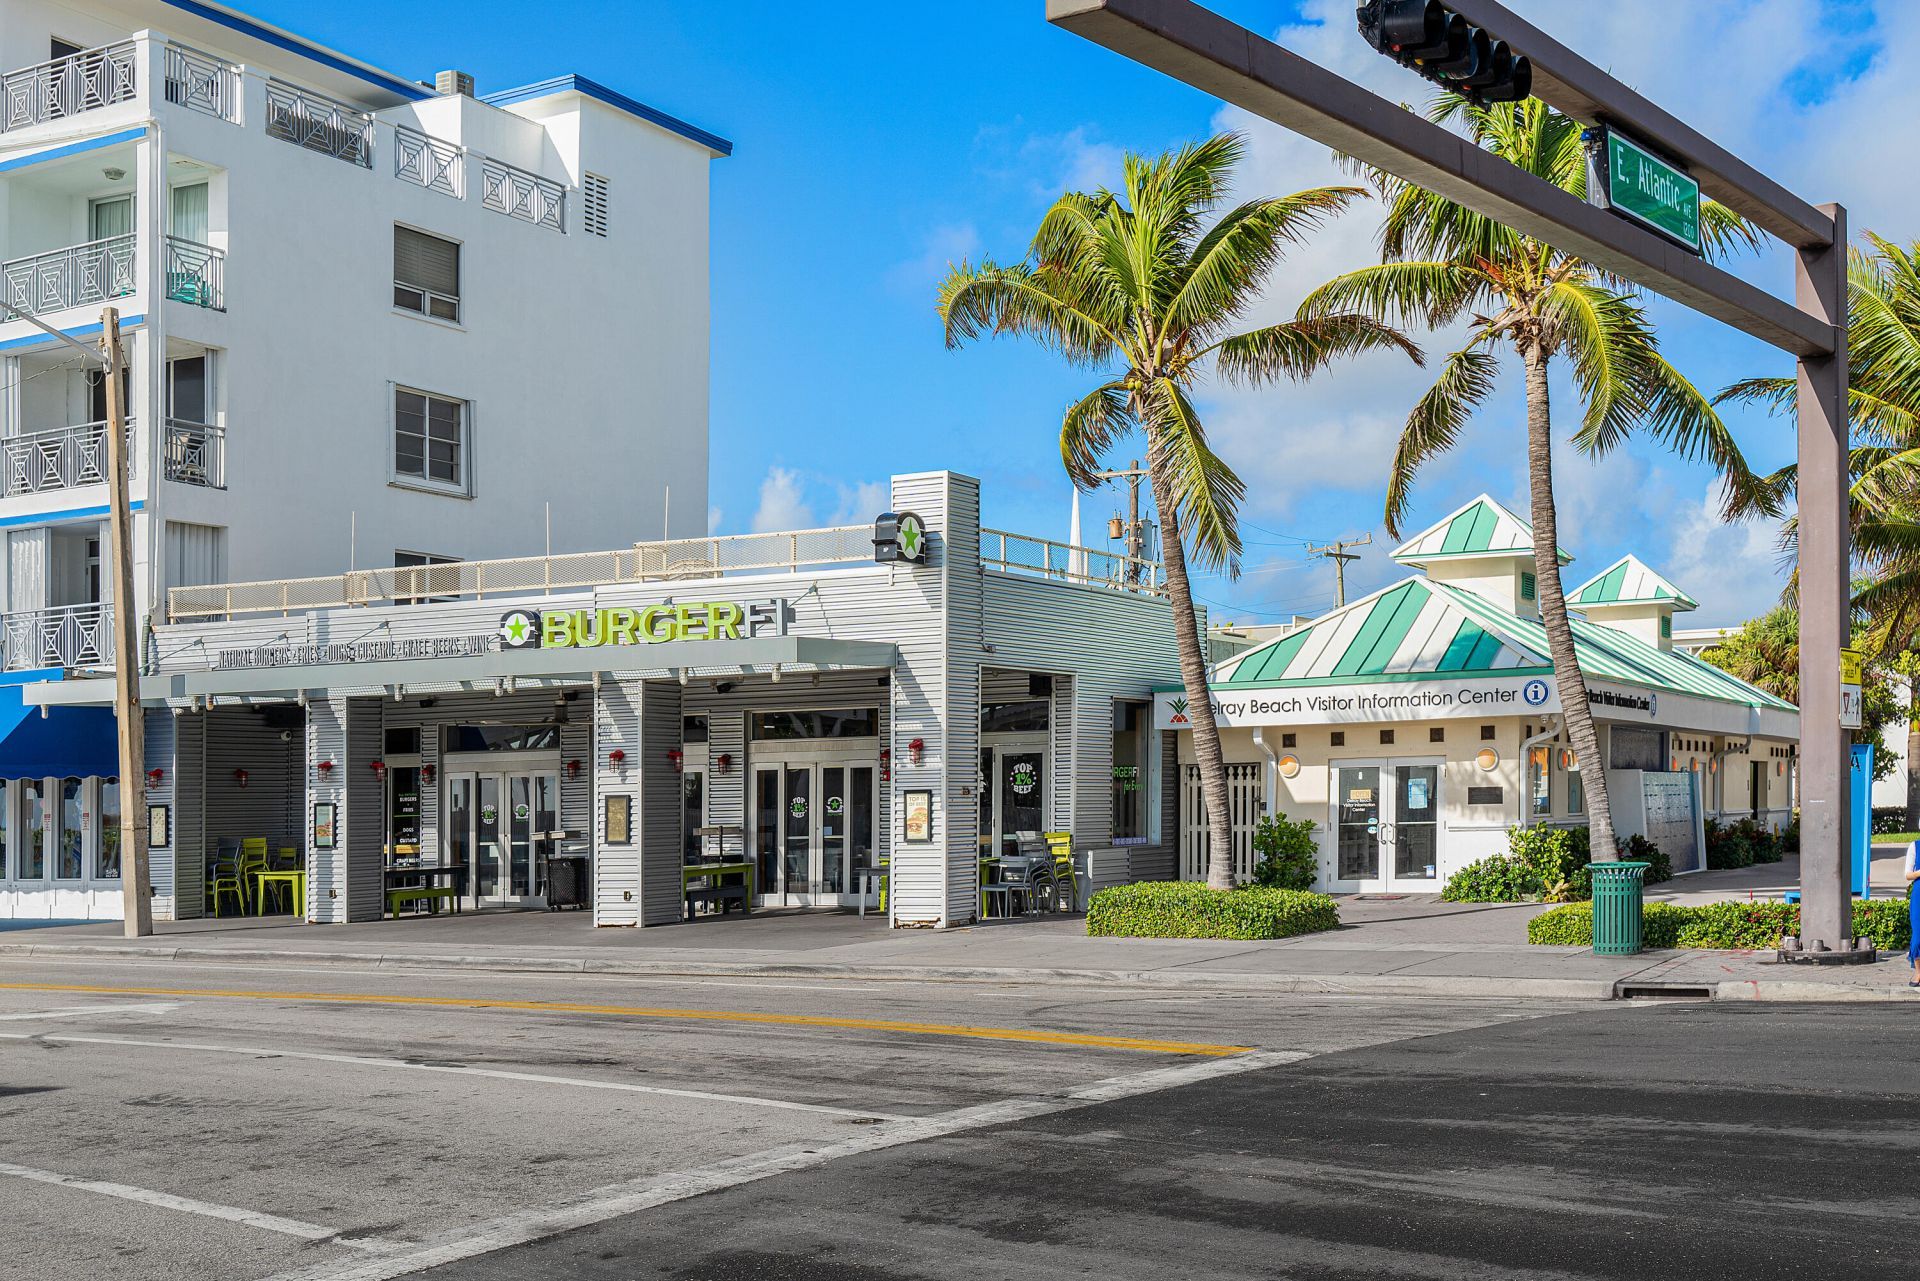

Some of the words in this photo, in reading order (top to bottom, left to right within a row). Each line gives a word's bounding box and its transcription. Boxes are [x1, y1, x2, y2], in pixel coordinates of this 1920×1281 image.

[1616, 144, 1630, 185] E.
[1638, 157, 1680, 212] Atlantic
[1683, 201, 1692, 219] AVE
[542, 598, 789, 649] BURGERFI
[219, 648, 253, 669] NATURAL
[254, 646, 289, 667] BURGERS
[298, 644, 320, 664] FRIES
[328, 643, 349, 662] DOGS
[357, 640, 395, 660] CUSTARD
[403, 638, 429, 658] CRAFT
[432, 637, 460, 657] BEERS
[1210, 701, 1246, 718] elray
[1250, 697, 1302, 714] Beach
[1307, 695, 1353, 712] Visitor
[1358, 690, 1453, 710] Information
[1457, 687, 1518, 705] Center
[1013, 762, 1033, 774] TOP
[1015, 773, 1032, 785] 1%
[1013, 784, 1033, 794] BEEF
[792, 796, 806, 804] TOP
[793, 803, 805, 812] 1%
